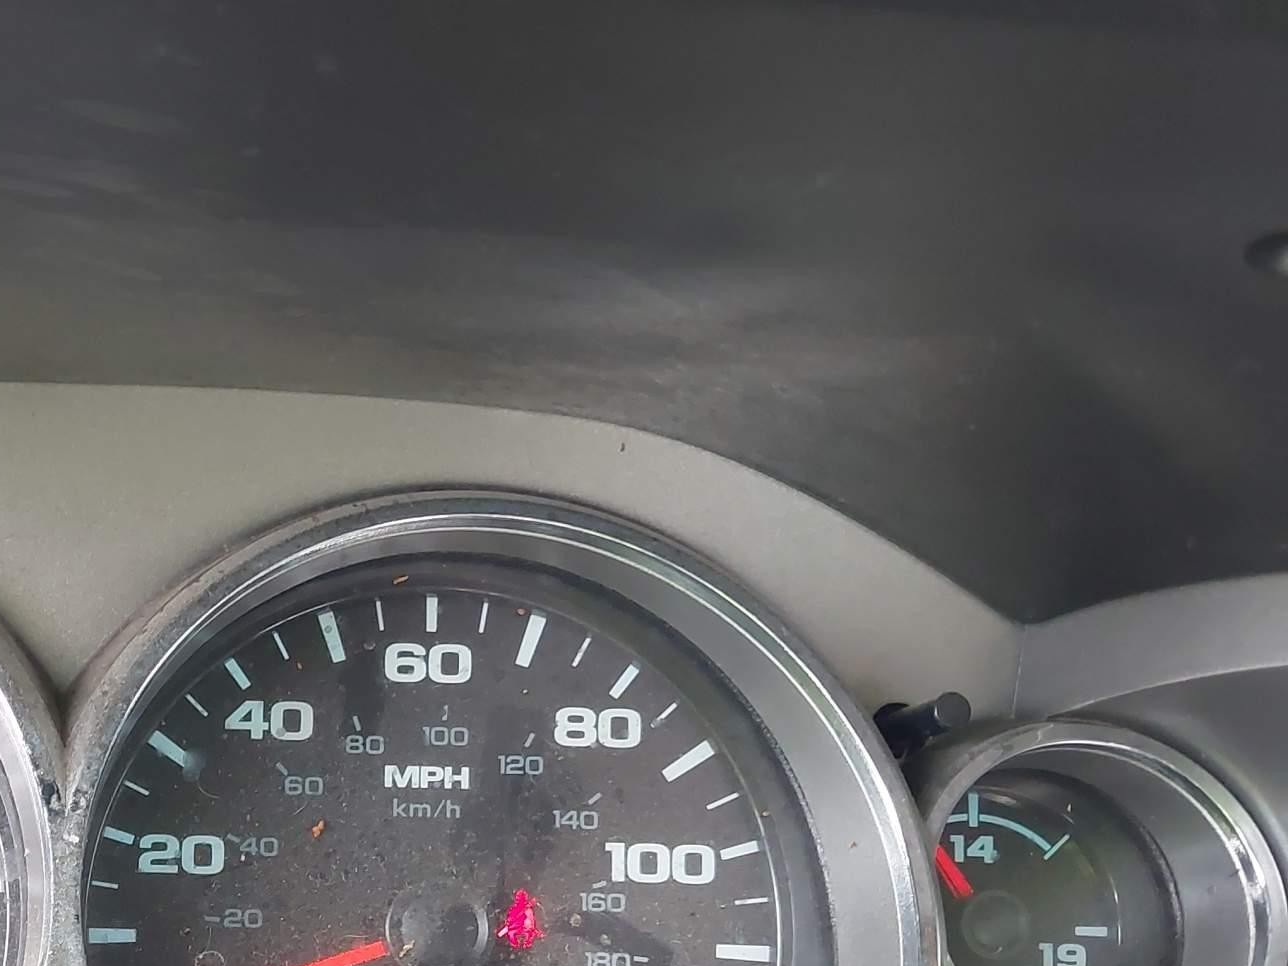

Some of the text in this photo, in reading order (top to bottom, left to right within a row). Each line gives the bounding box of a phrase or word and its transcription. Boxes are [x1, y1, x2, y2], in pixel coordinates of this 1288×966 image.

[384, 642, 472, 684] 60
[224, 700, 314, 742] 40
[554, 706, 642, 749] 80
[344, 734, 386, 755] 80
[422, 725, 469, 747] 100
[497, 754, 545, 776] 120
[283, 776, 324, 796] 60
[383, 764, 471, 790] MPH
[391, 797, 462, 819] km/h
[552, 809, 599, 831] 140
[137, 833, 225, 876] 20
[238, 836, 280, 858] 40
[949, 834, 997, 864] 14
[604, 841, 716, 885] 100
[579, 892, 627, 913] 160
[222, 908, 264, 929] 20
